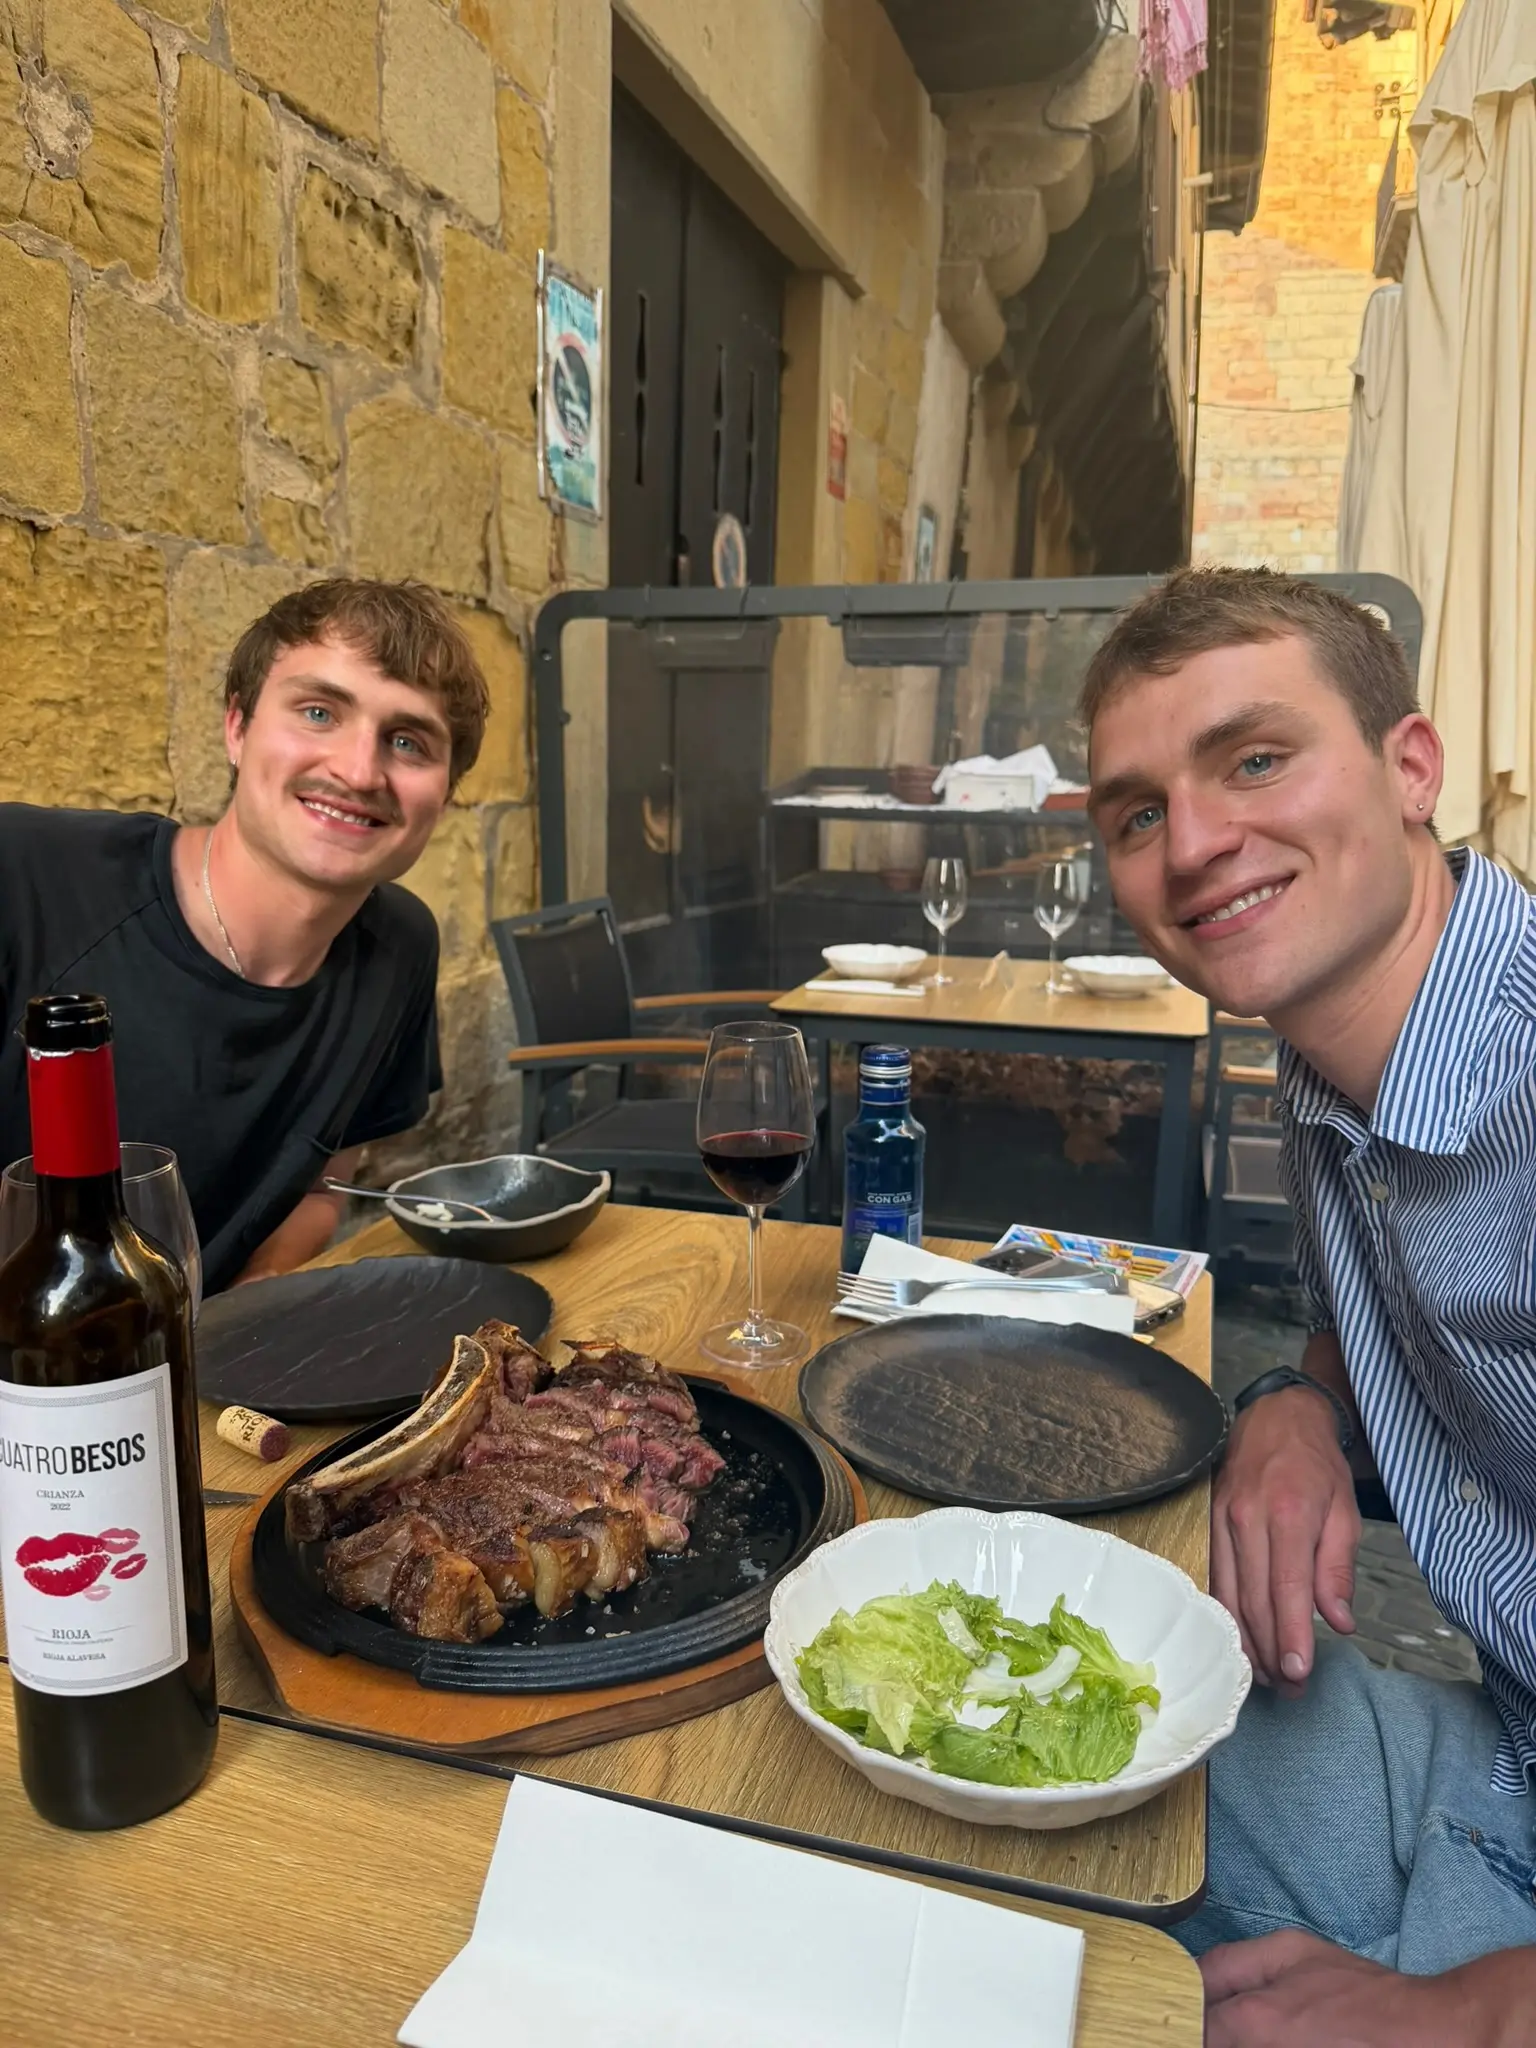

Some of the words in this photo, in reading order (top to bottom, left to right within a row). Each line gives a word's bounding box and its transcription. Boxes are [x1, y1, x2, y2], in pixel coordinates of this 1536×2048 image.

[867, 1195, 891, 1204] CON
[892, 1193, 912, 1204] GAS
[36, 1489, 85, 1500] CRIANZA
[50, 1502, 71, 1511] 2022
[52, 1628, 91, 1640] RIOJA
